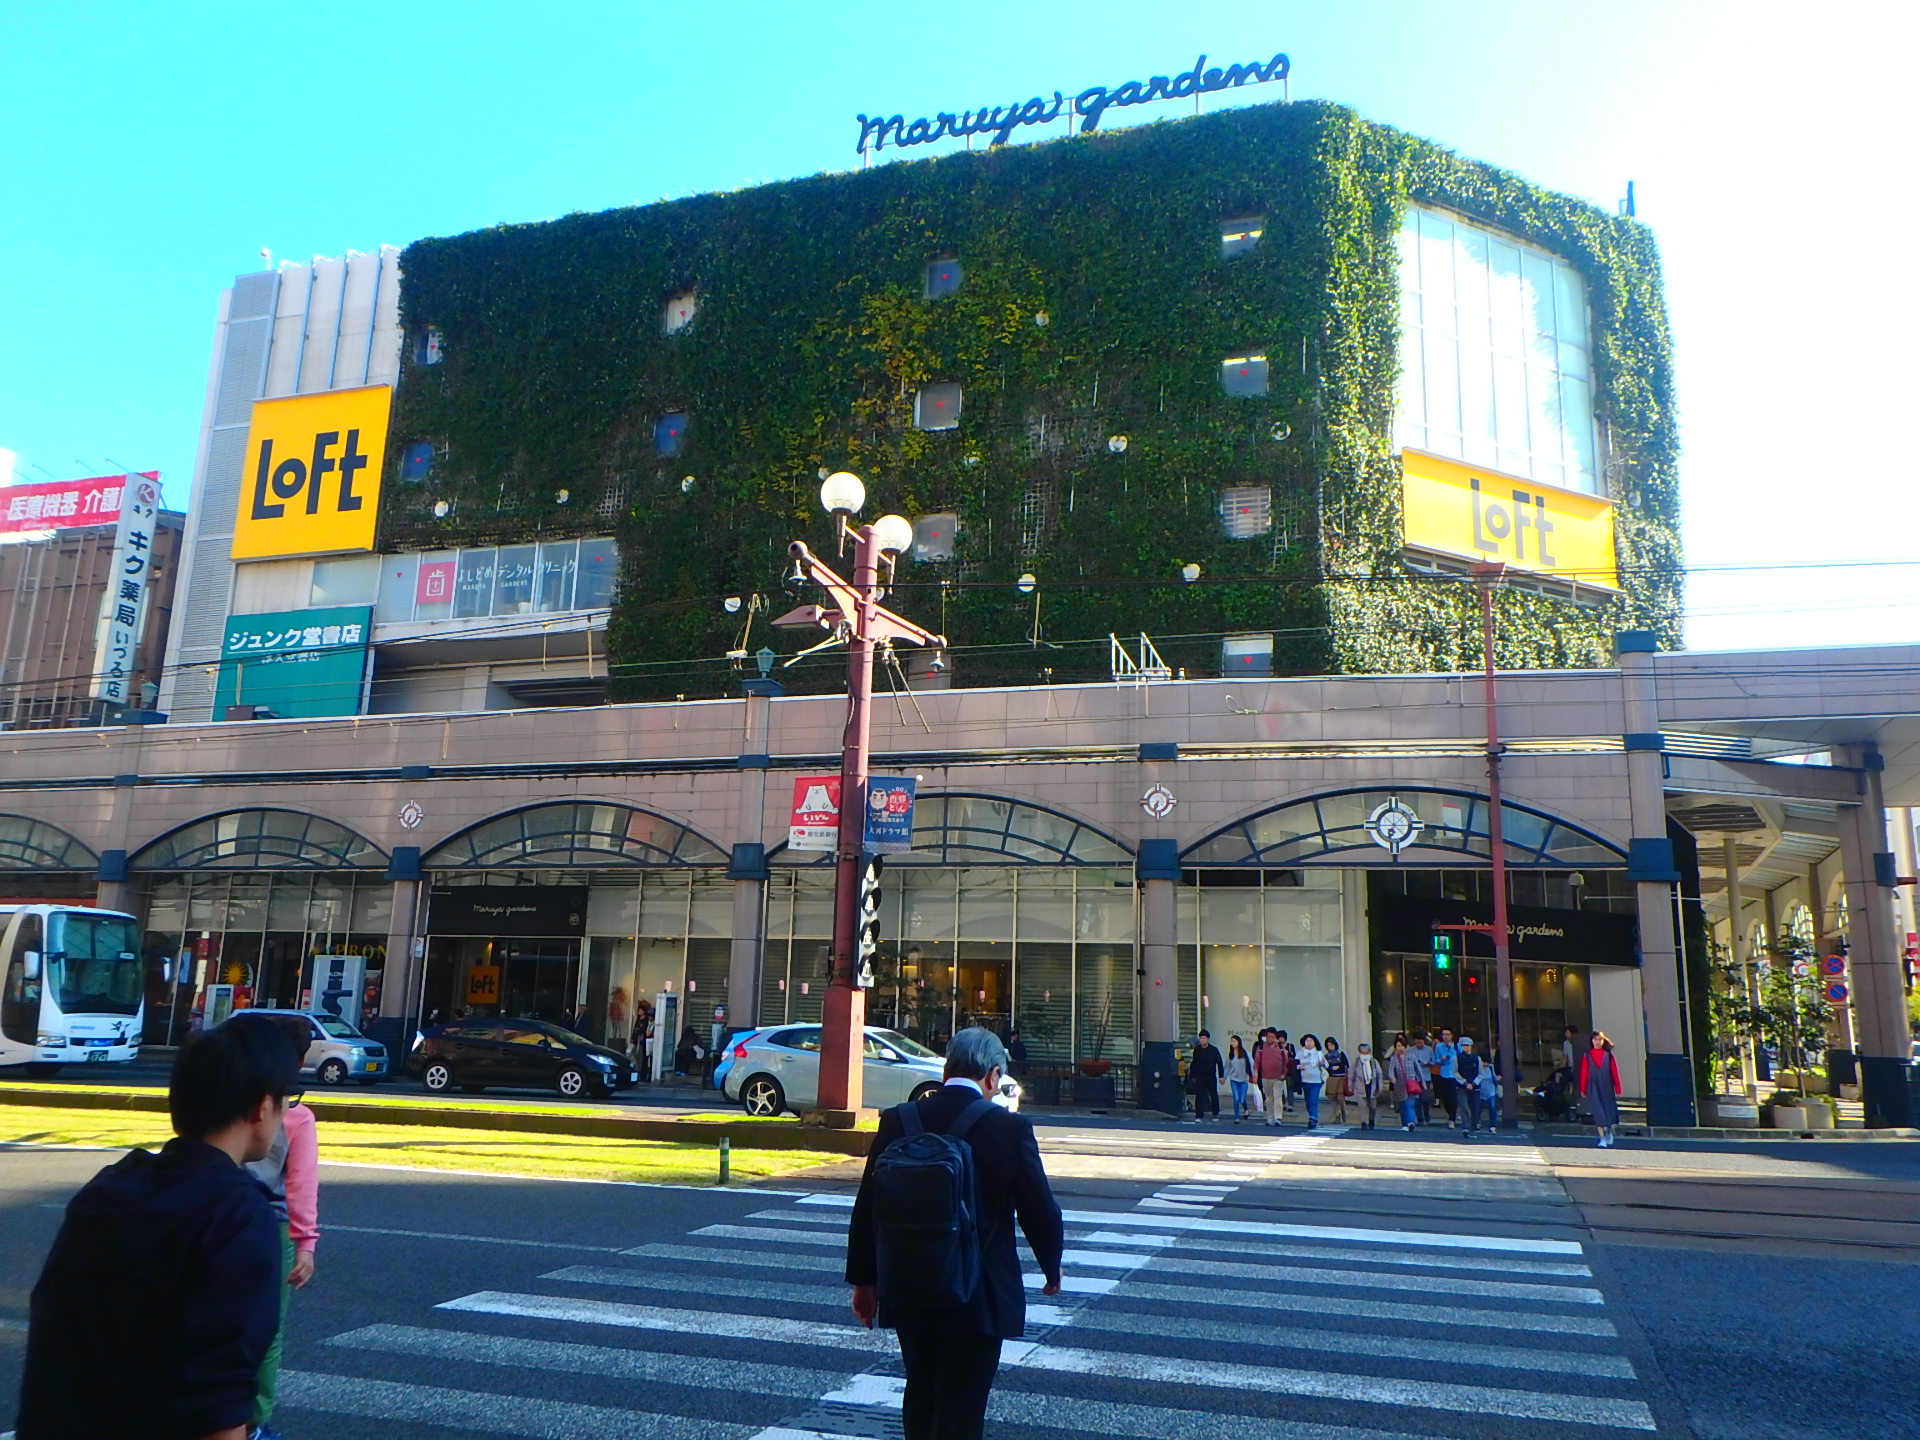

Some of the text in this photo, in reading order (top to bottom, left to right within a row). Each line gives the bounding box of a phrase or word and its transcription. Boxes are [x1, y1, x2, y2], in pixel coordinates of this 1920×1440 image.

[1075, 53, 1290, 132] gardens
[82, 485, 126, 514] 介護
[229, 623, 362, 651] ジュンク堂書店
[1517, 922, 1564, 944] gardens
